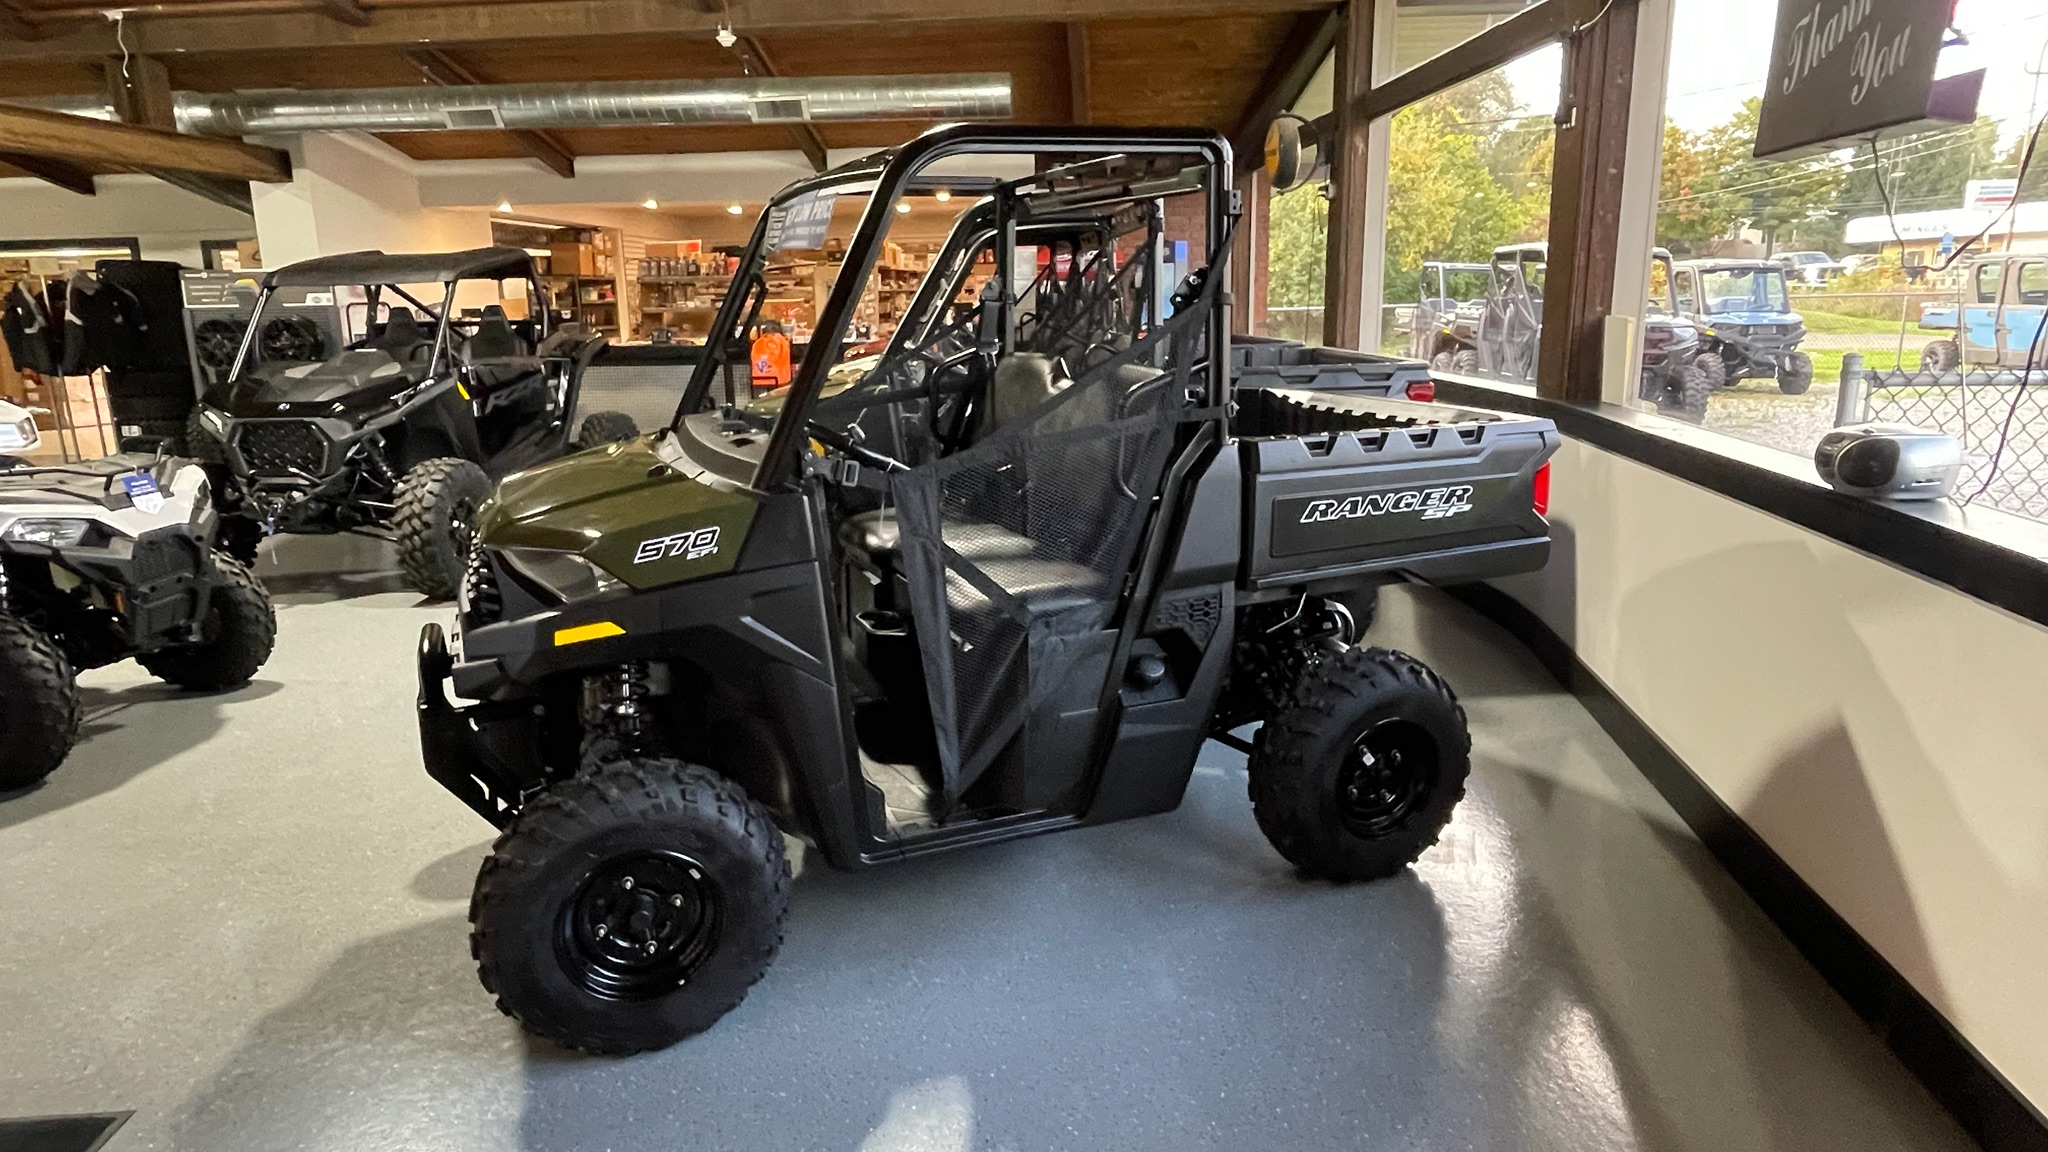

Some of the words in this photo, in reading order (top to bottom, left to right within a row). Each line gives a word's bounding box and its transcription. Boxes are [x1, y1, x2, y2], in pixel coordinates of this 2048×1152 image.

[1851, 22, 1911, 105] You
[1300, 485, 1474, 524] RANGER
[1421, 504, 1473, 521] SP
[633, 526, 720, 564] 570
[686, 546, 719, 560] EFI
